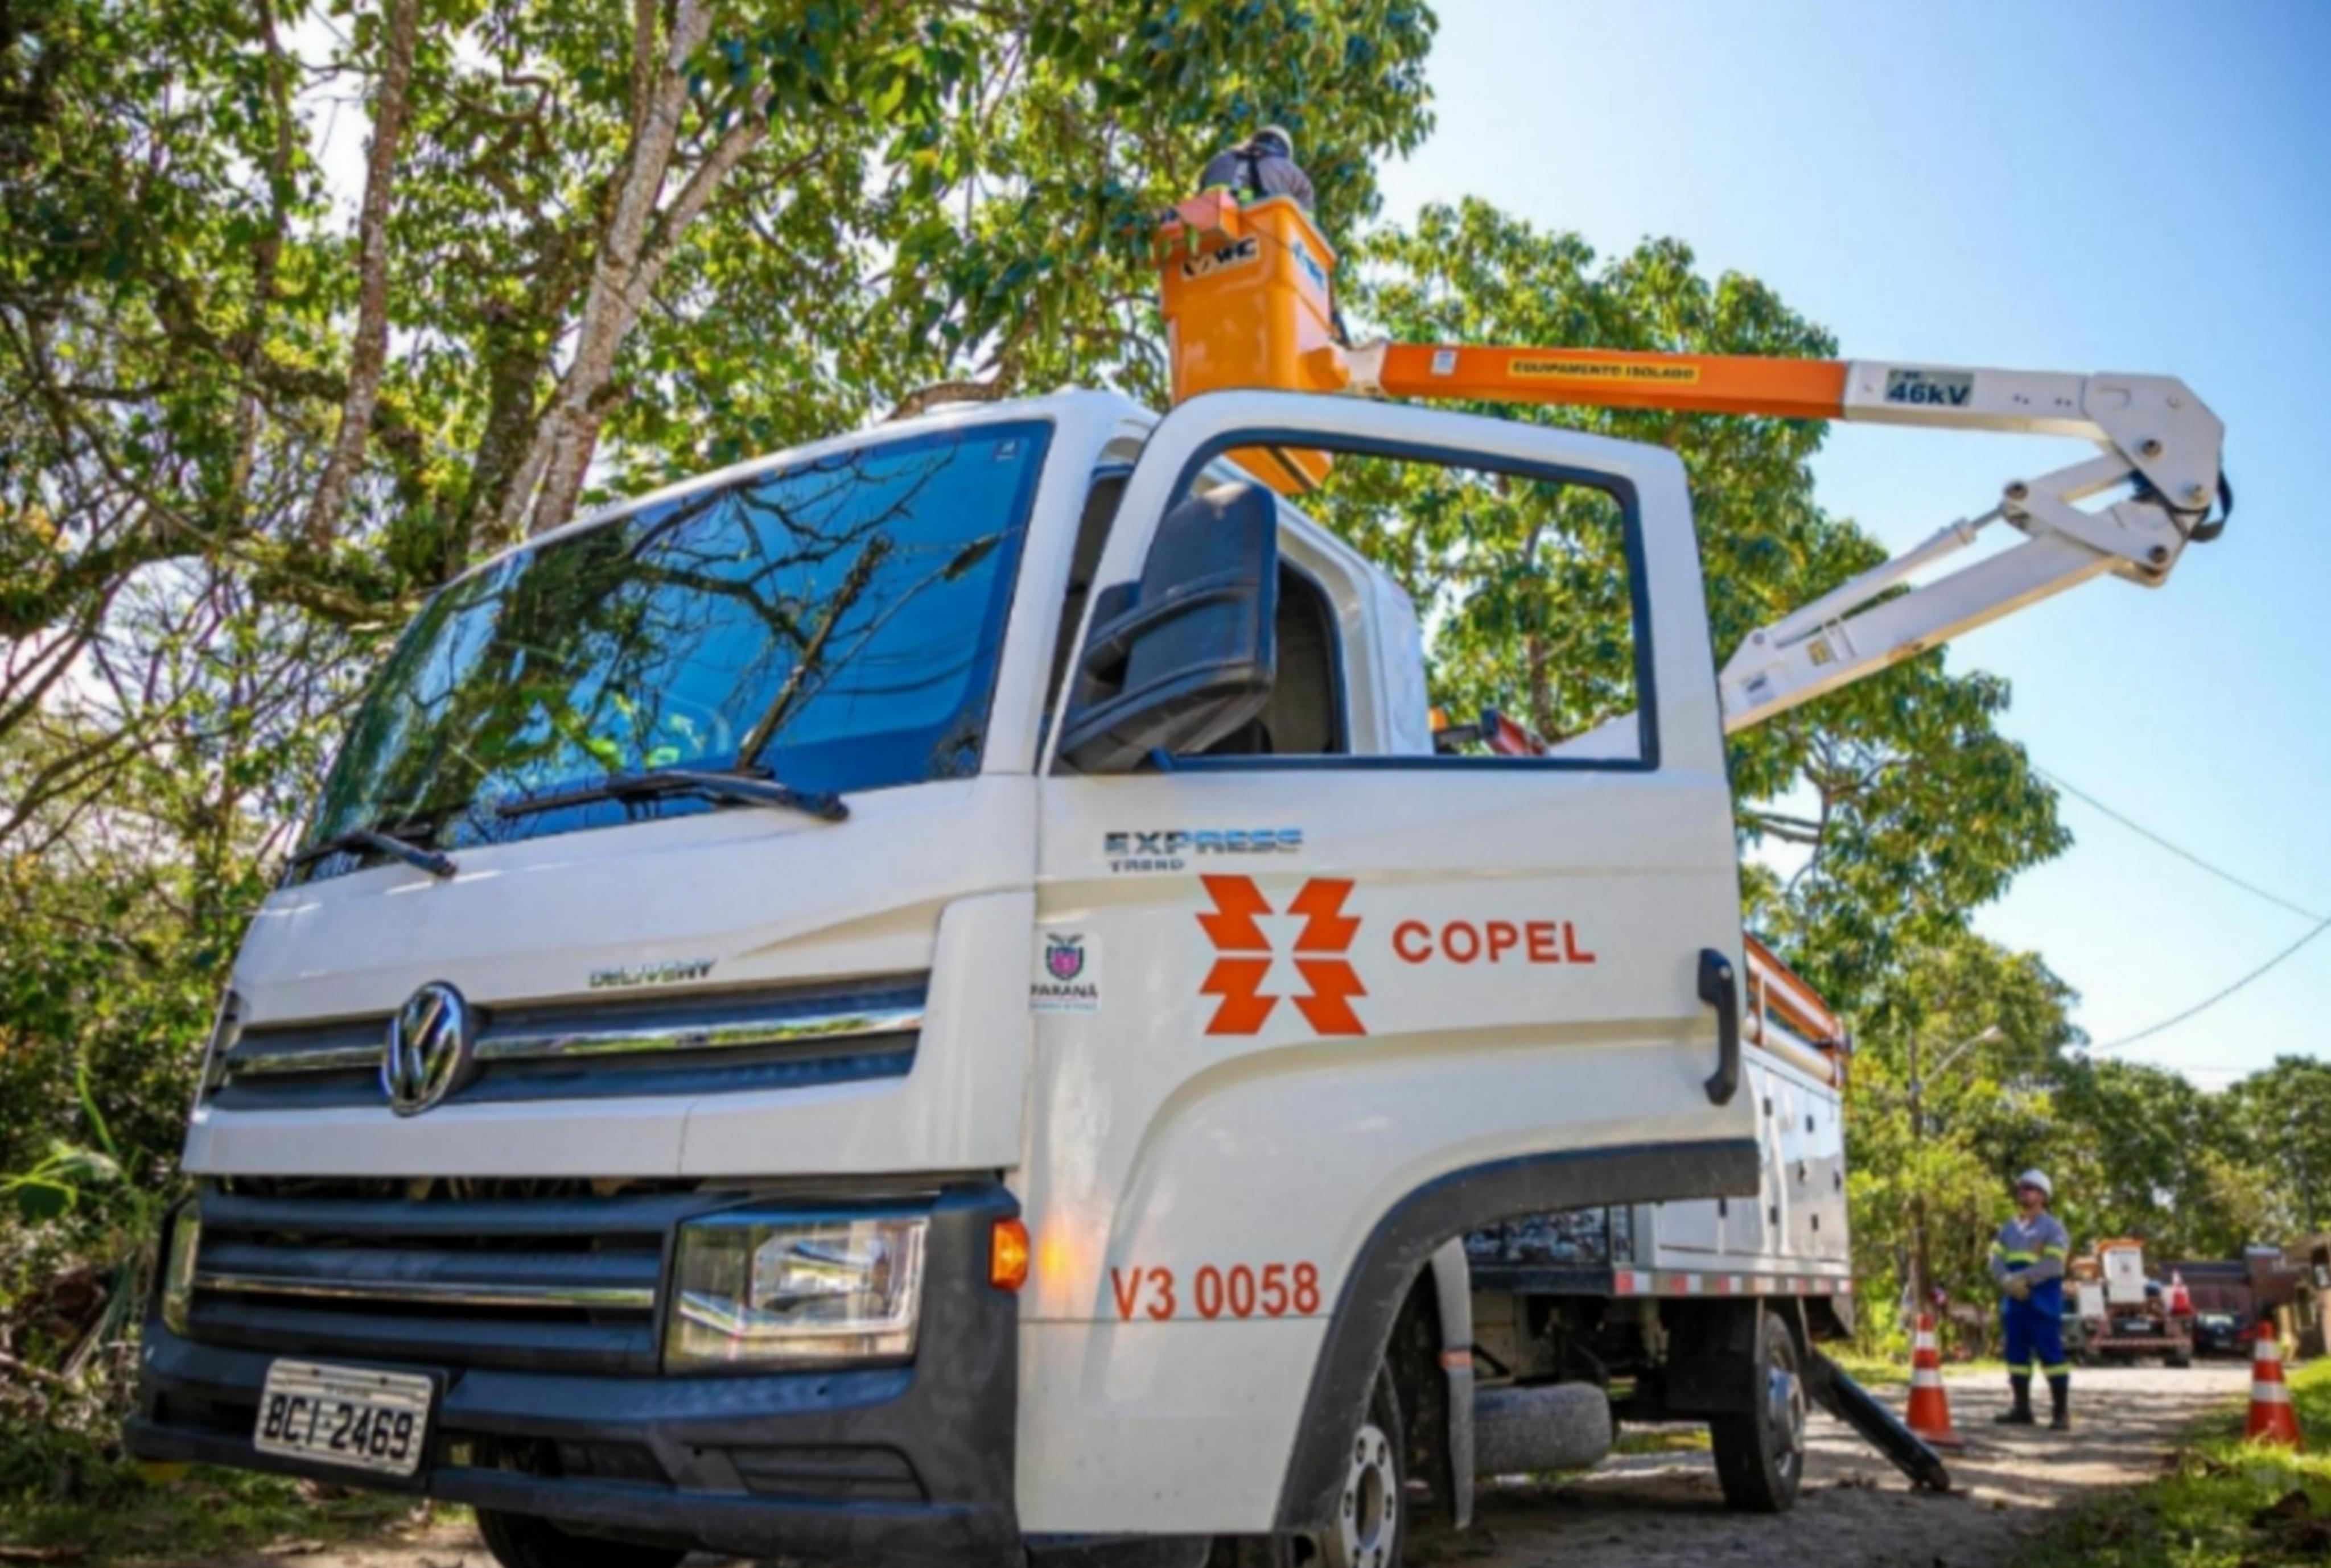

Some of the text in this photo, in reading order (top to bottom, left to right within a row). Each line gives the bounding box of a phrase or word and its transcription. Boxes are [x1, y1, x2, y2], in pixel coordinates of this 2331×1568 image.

[1513, 360, 1695, 379] EQUIPAMENTO ISOLADO
[1887, 382, 1971, 406] 46kV
[1104, 828, 1303, 855] EXPRESS
[1109, 858, 1185, 873] TREND
[1392, 919, 1596, 964] COPEL
[1110, 1260, 1320, 1323] V3 0058
